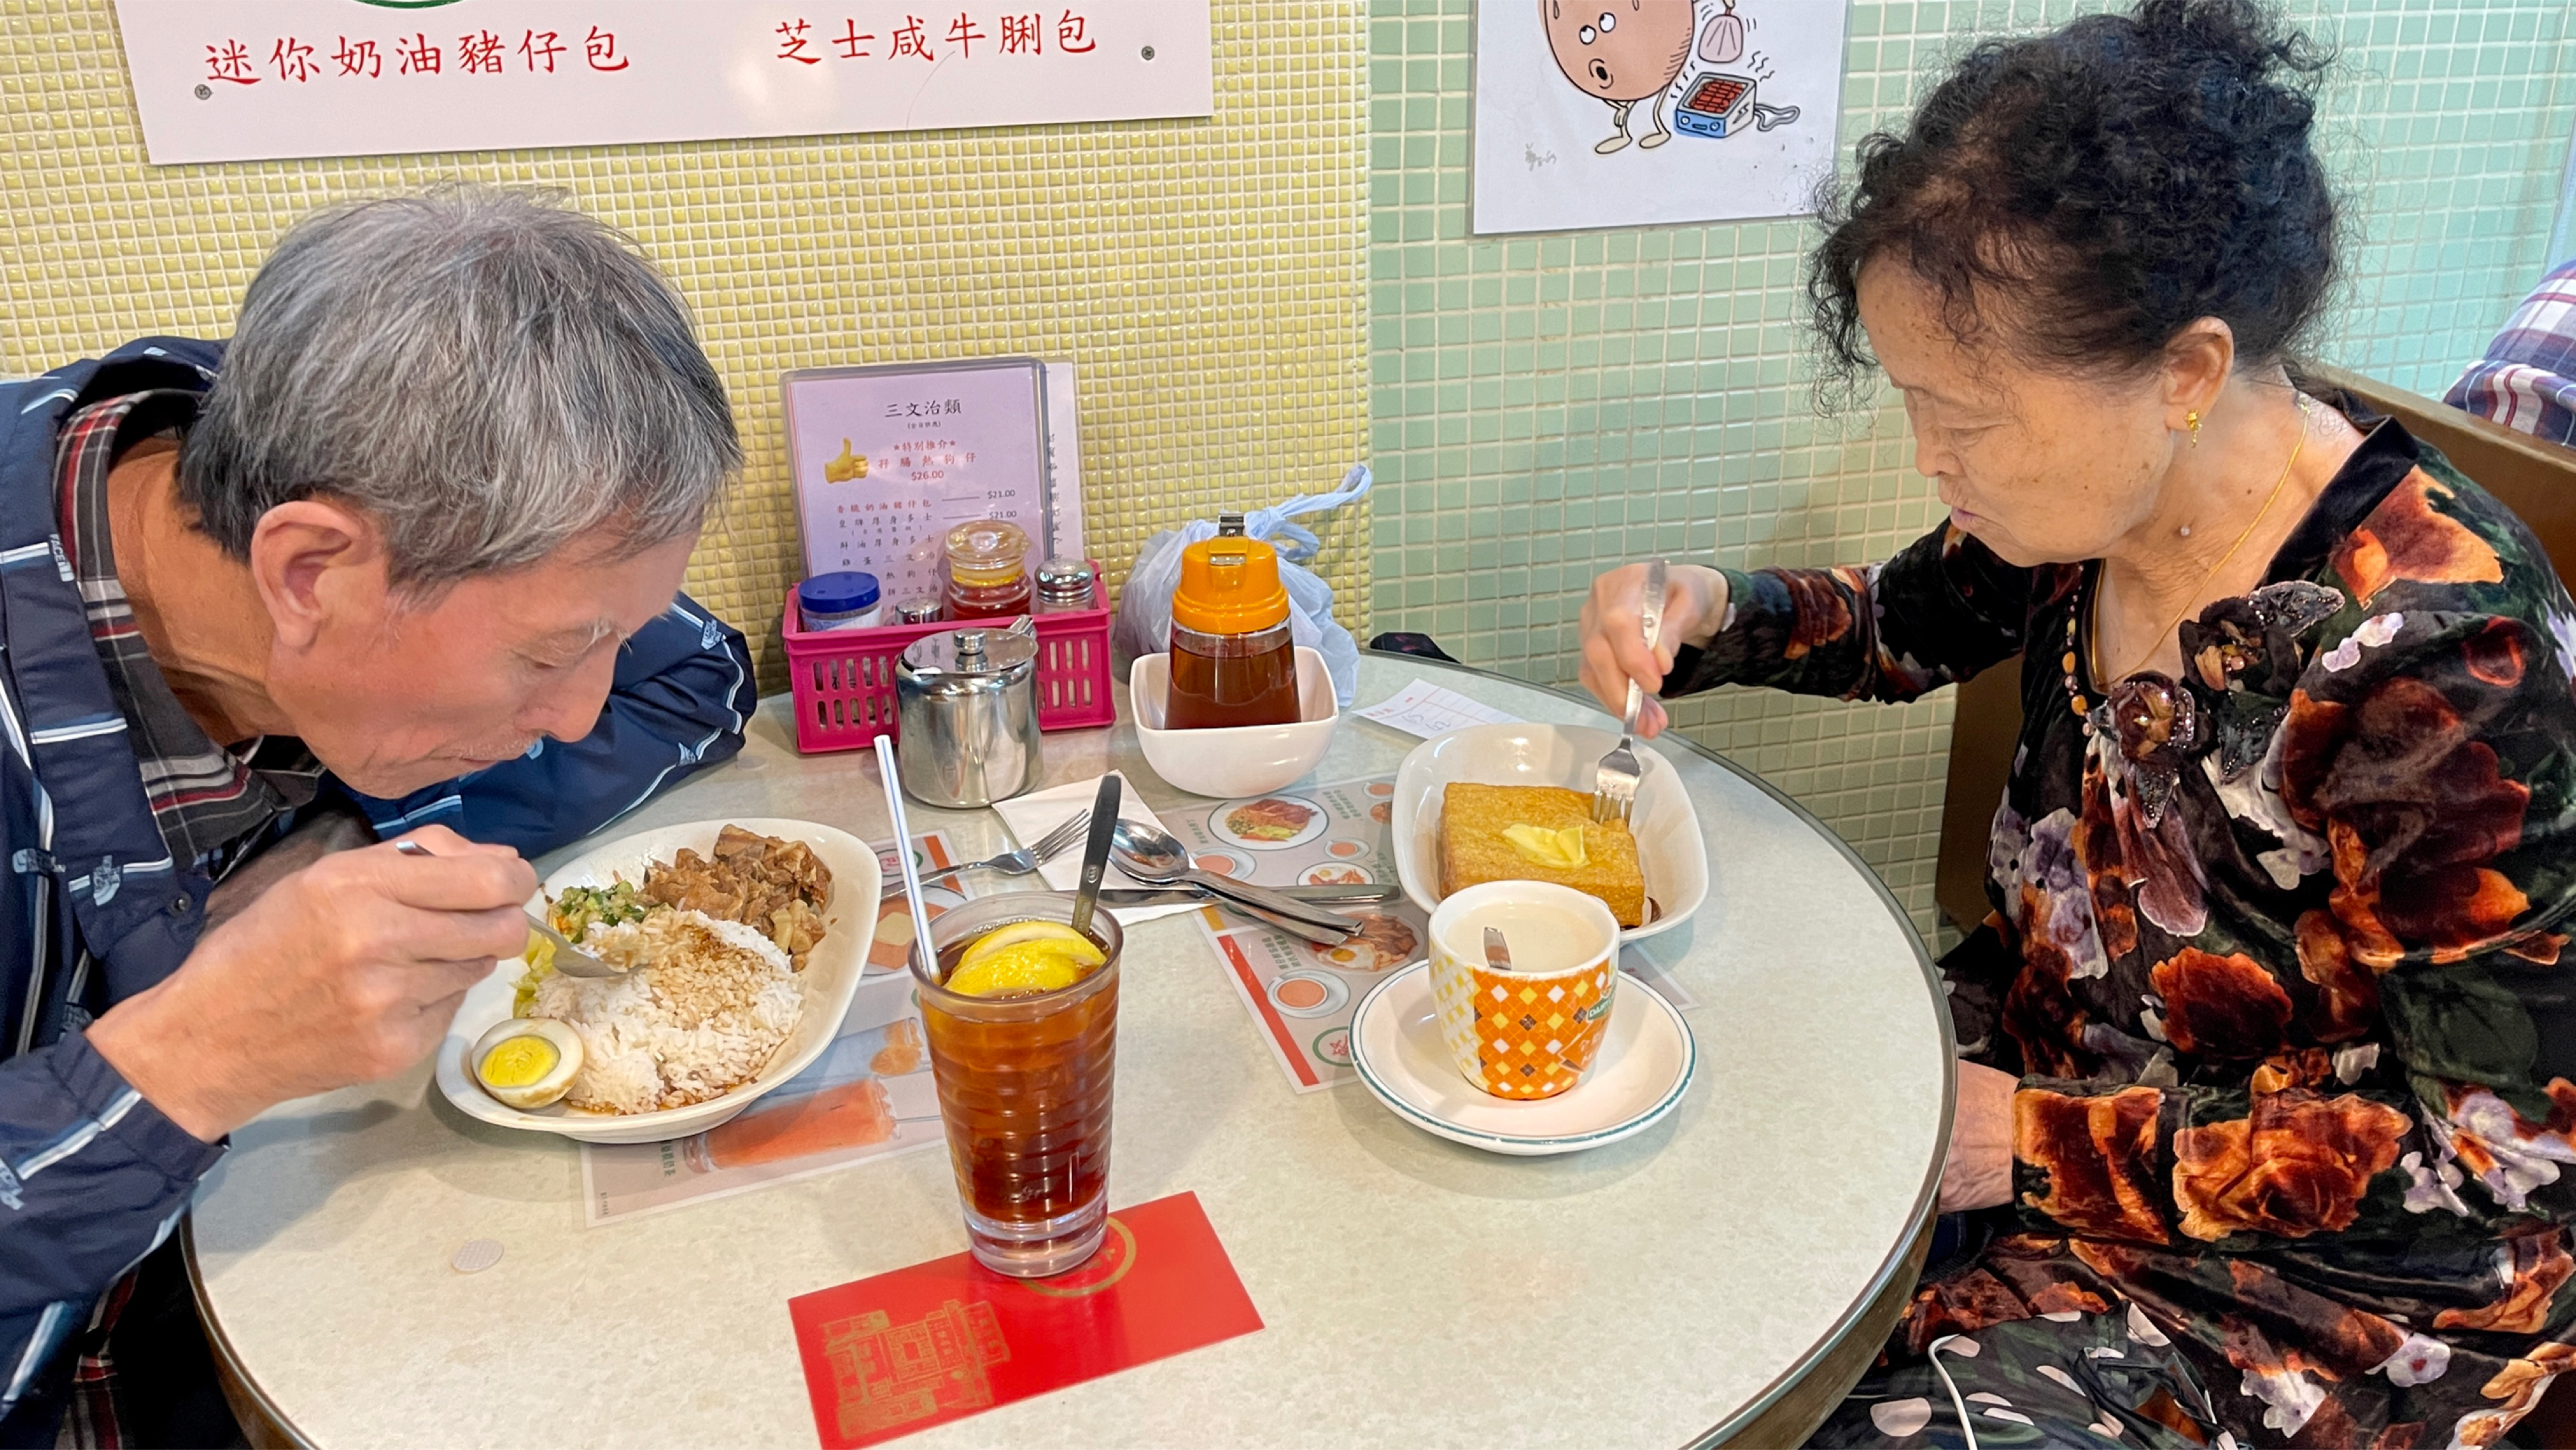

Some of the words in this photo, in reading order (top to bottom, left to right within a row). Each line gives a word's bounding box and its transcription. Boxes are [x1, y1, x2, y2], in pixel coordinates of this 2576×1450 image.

[775, 9, 1097, 65] 芝士咸牛脷包
[204, 24, 632, 86] 迷你奶油豬仔包
[884, 398, 962, 417] 三文治類
[910, 470, 944, 481] $26.00
[987, 490, 1016, 499] $21.00
[989, 510, 1017, 520] $21.00
